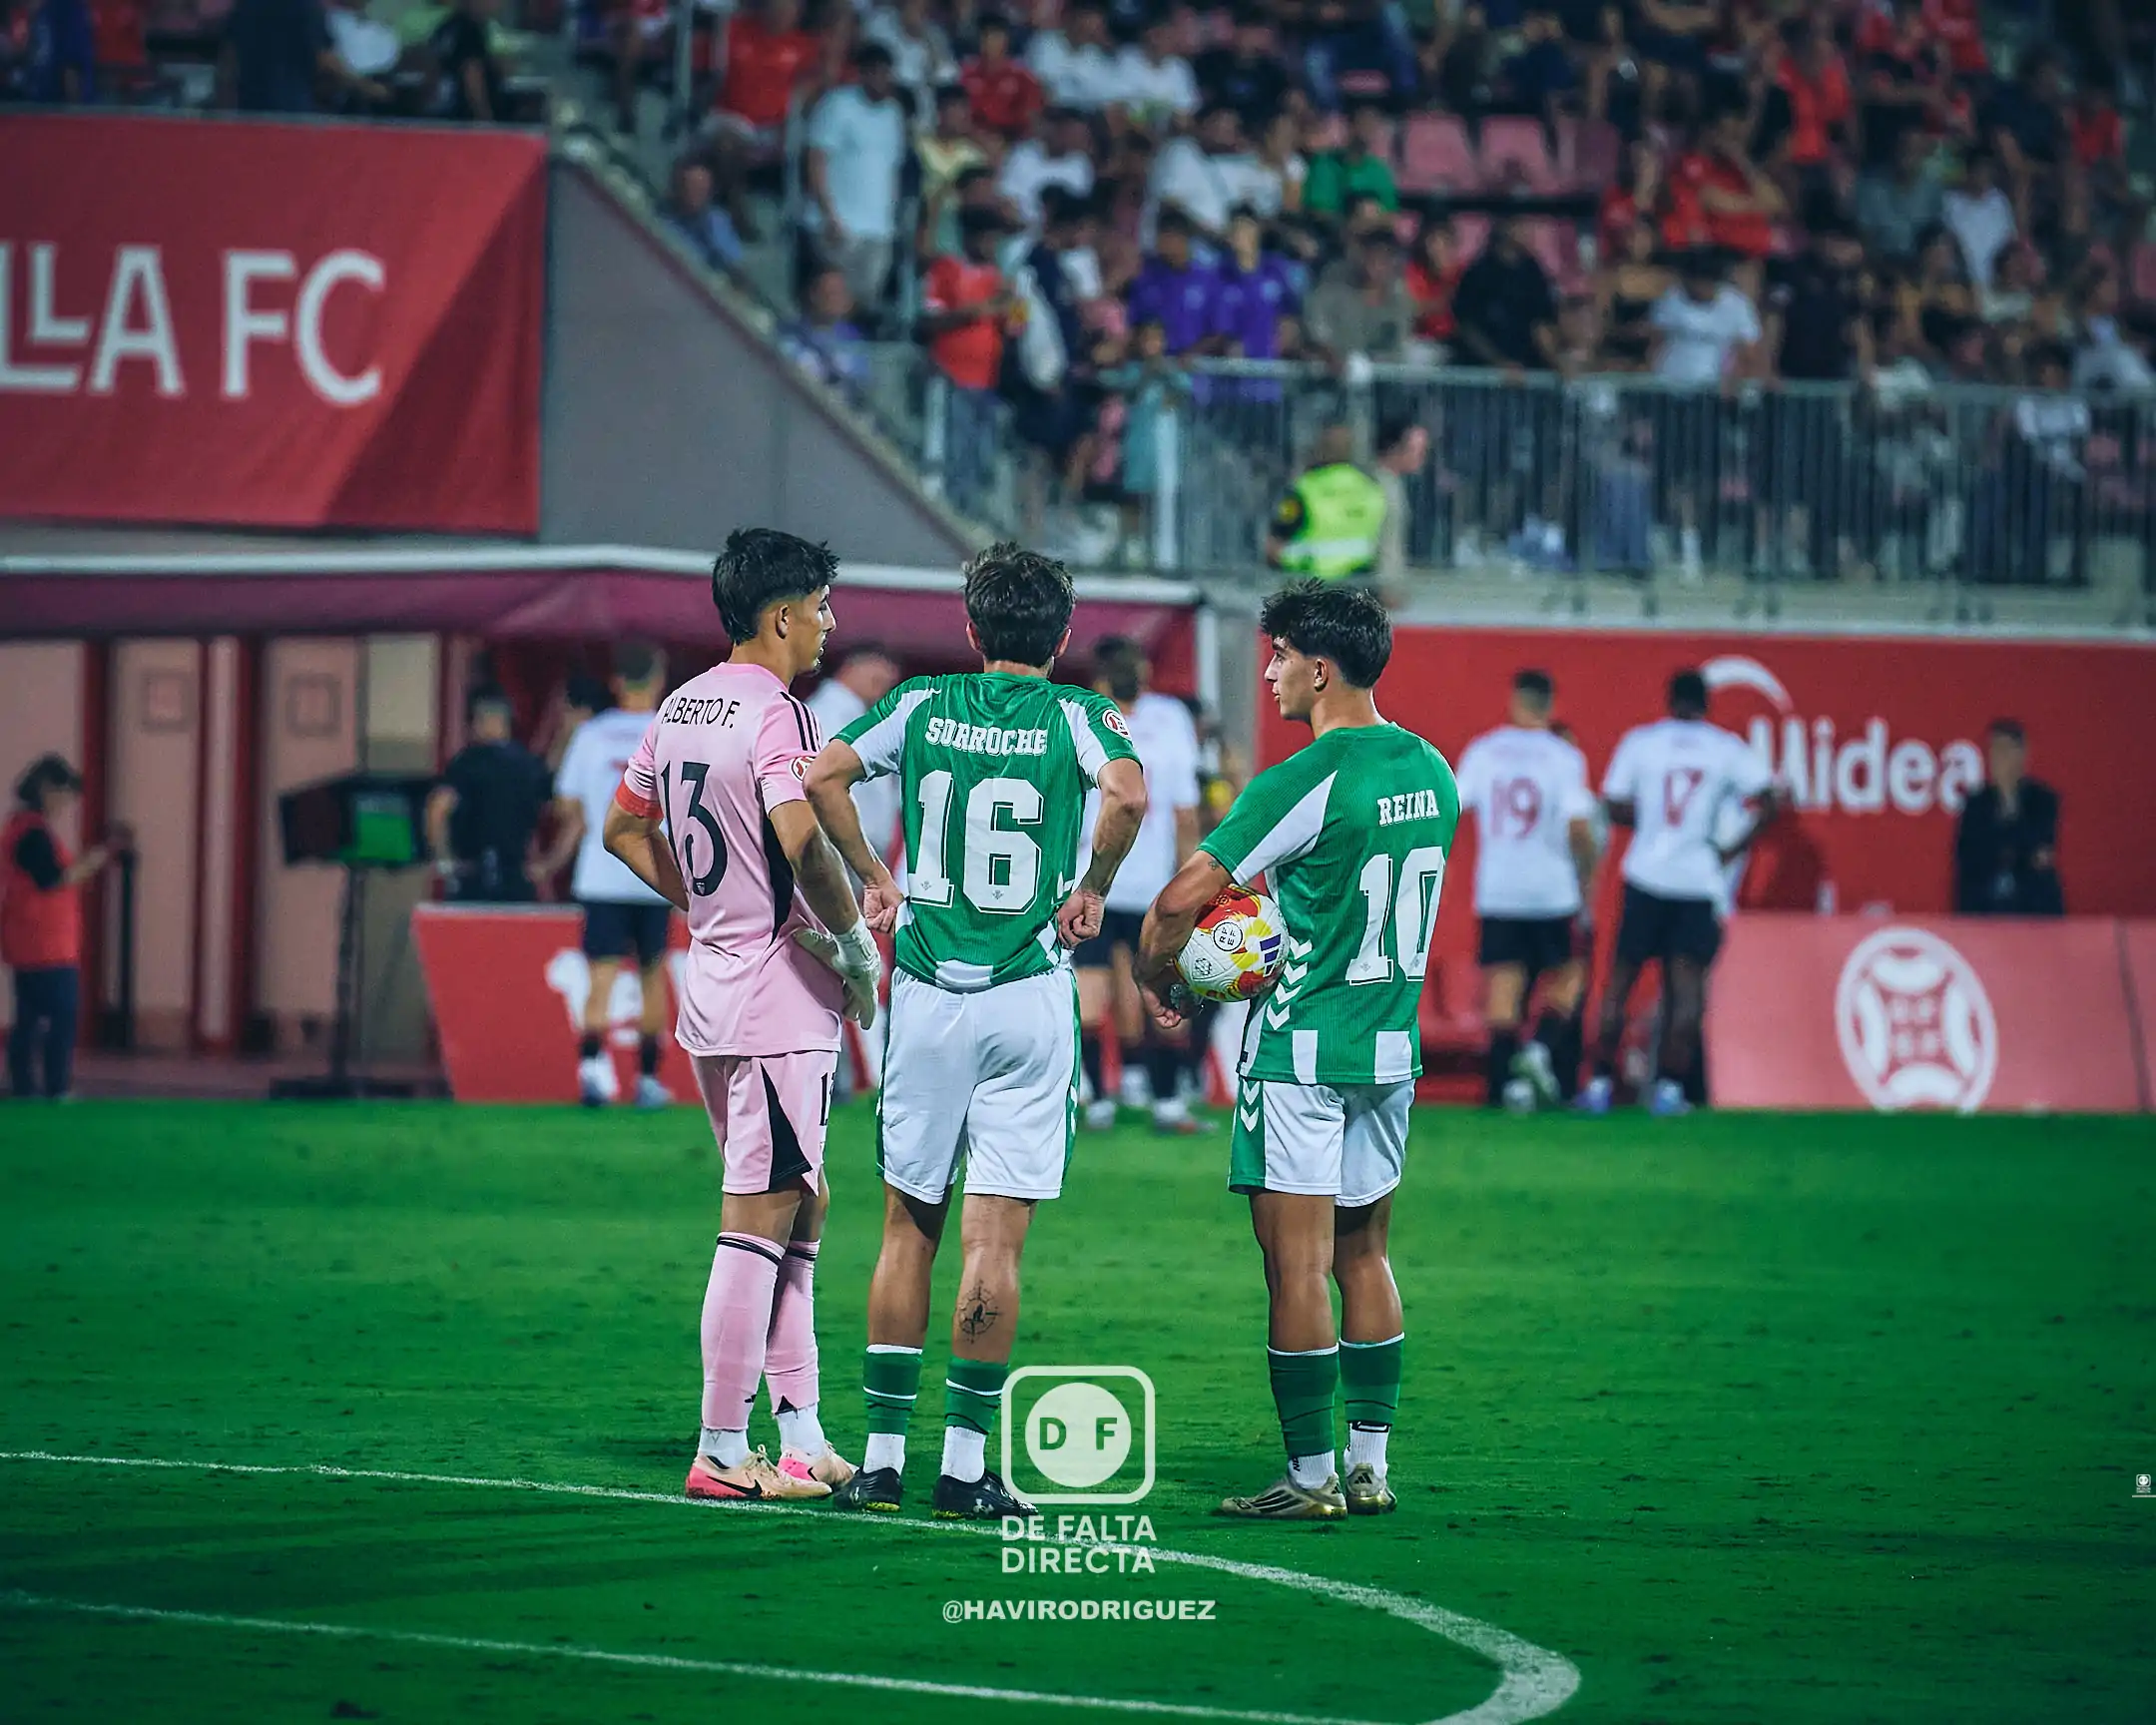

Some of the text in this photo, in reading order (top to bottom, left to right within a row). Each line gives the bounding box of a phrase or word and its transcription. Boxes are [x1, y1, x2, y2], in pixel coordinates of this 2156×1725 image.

[223, 248, 386, 405] FC
[721, 700, 741, 729] F.
[660, 760, 729, 896] 13
[907, 770, 1044, 915] 16
[1376, 789, 1441, 827] REINA
[1490, 777, 1543, 841] 19
[1345, 845, 1445, 986] 10
